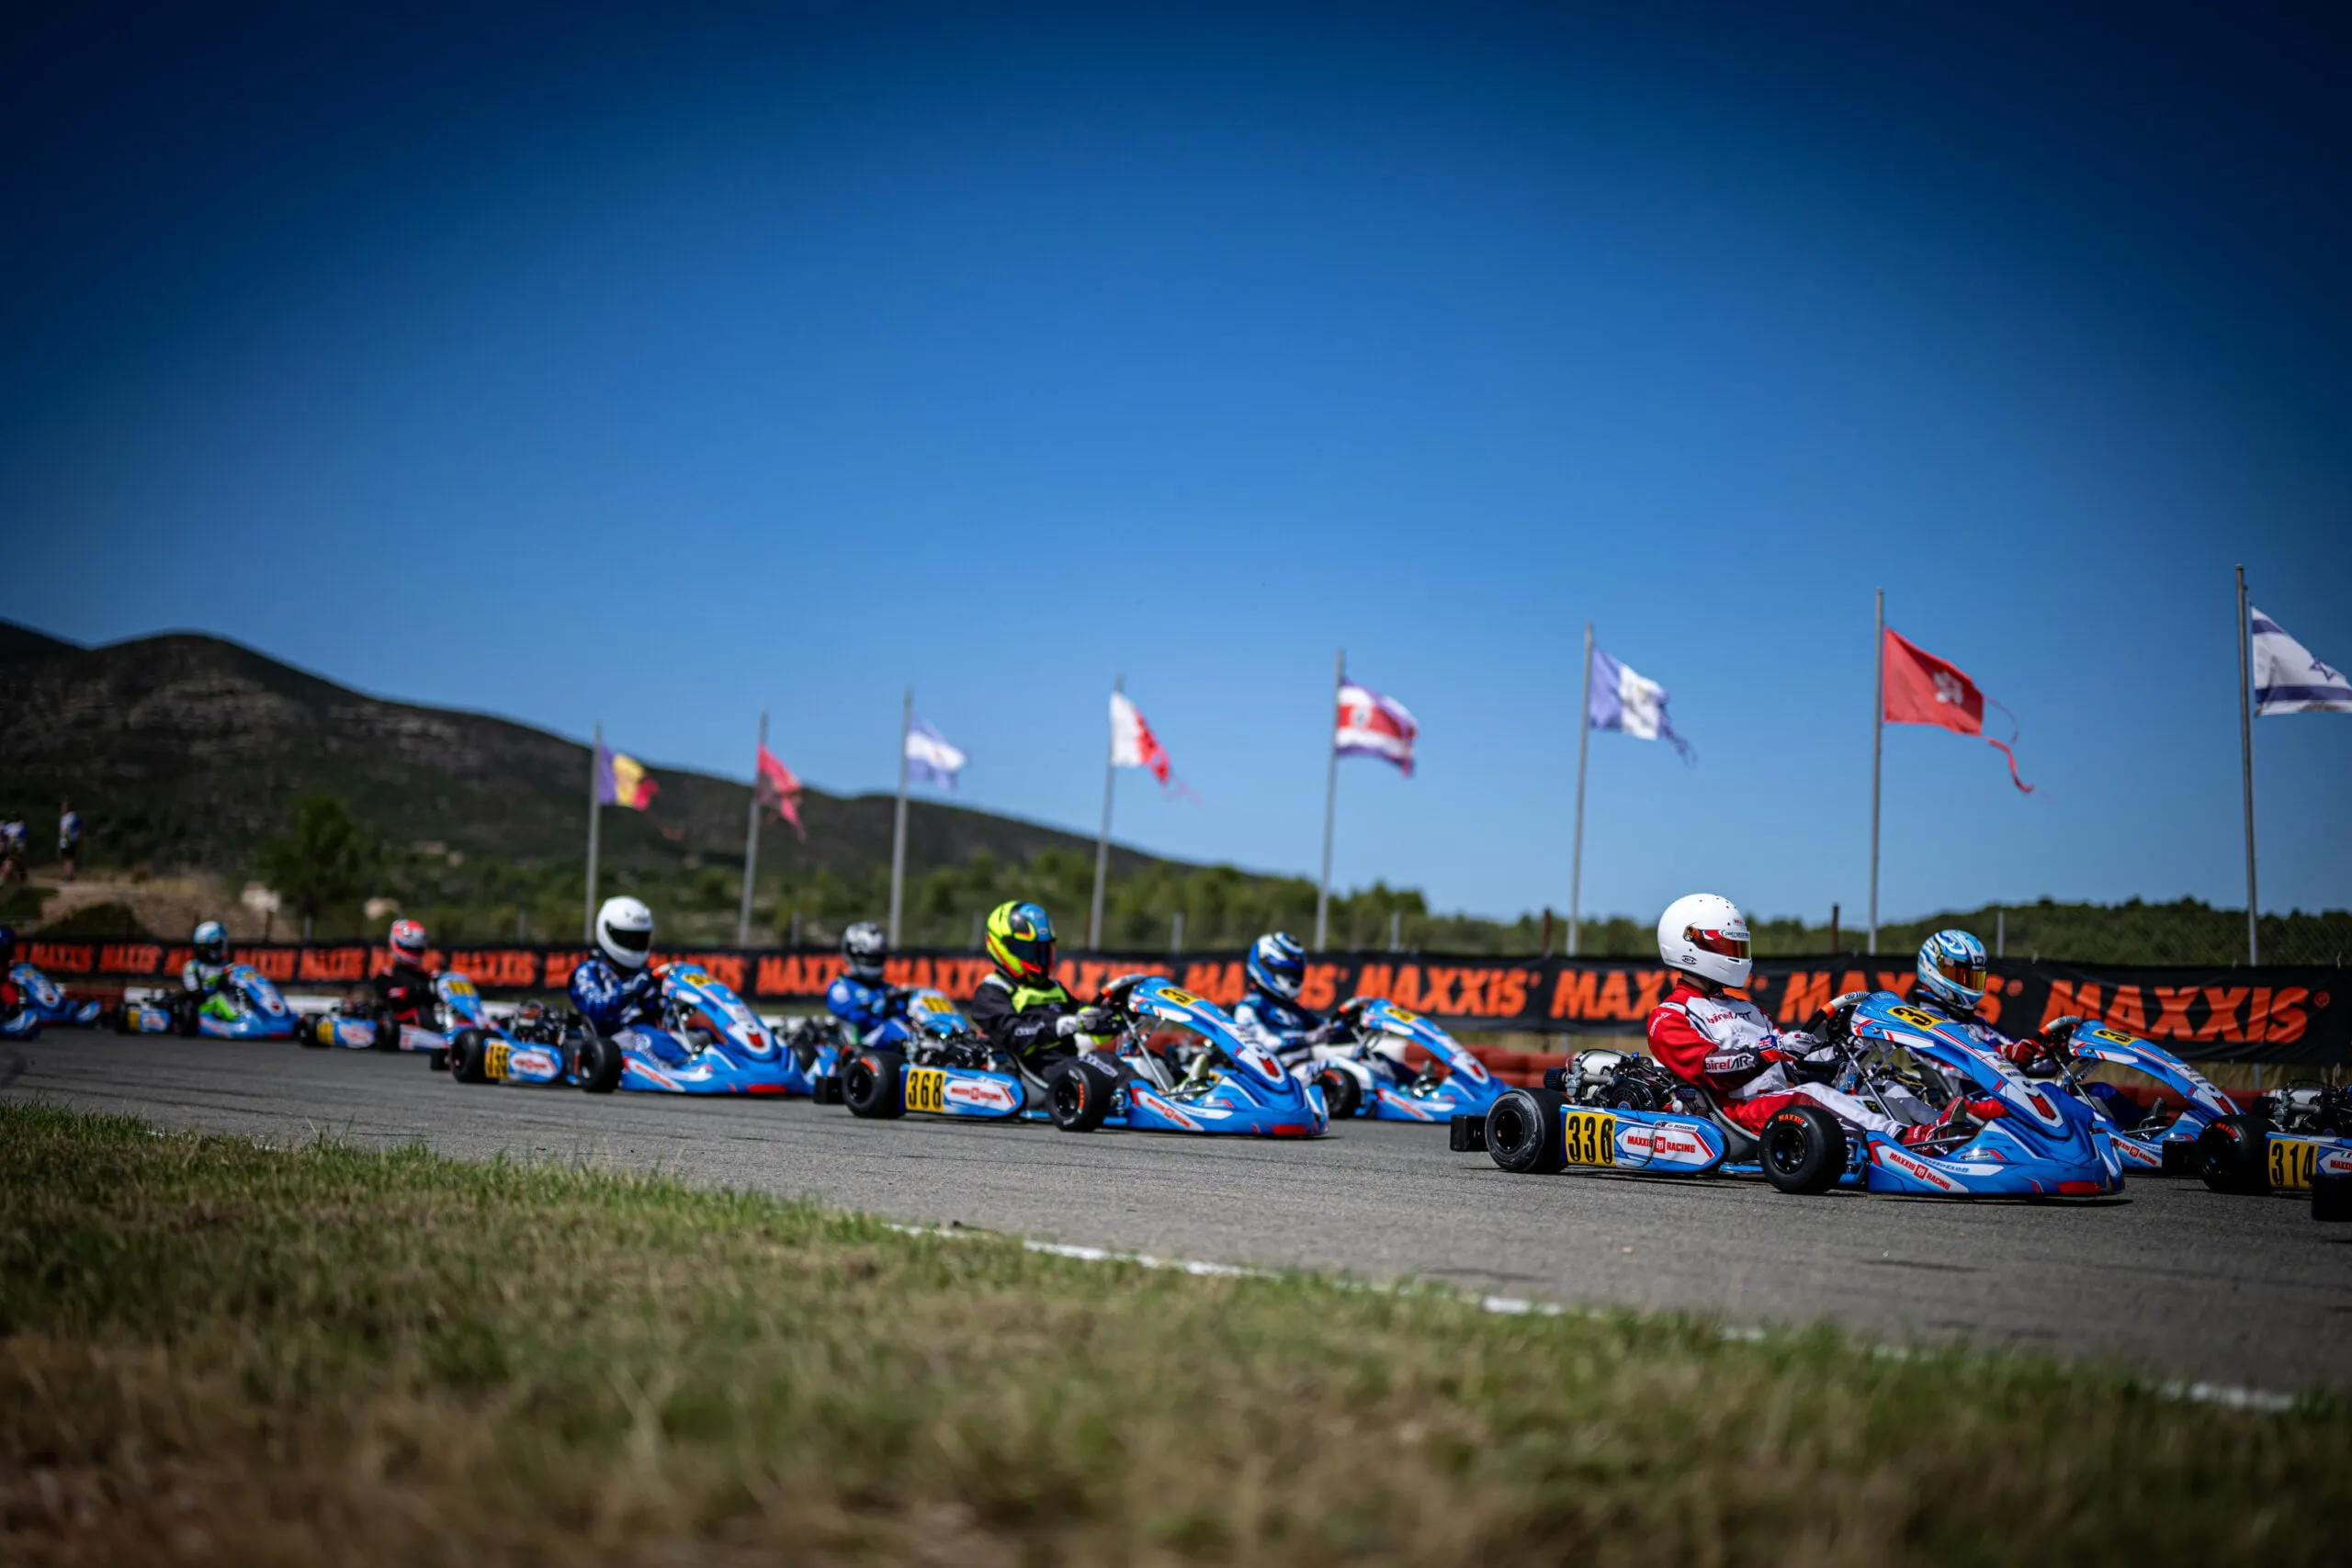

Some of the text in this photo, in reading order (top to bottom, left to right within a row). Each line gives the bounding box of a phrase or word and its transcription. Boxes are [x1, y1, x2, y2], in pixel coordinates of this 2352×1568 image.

[1184, 961, 1337, 1010] MAIS
[1355, 963, 1528, 1017] MAXXIS
[1551, 969, 1752, 1020] MAX
[1778, 970, 2004, 1024] MAXS
[2038, 979, 2309, 1043] MAXXIS
[908, 1071, 943, 1109] 368
[1779, 1114, 1804, 1125] MAXXIS
[1568, 1115, 1613, 1165] 336
[1627, 1135, 1695, 1153] MAXXIS RACING
[1889, 1152, 1951, 1190] MAXXIS RACING
[2271, 1143, 2315, 1187] 314
